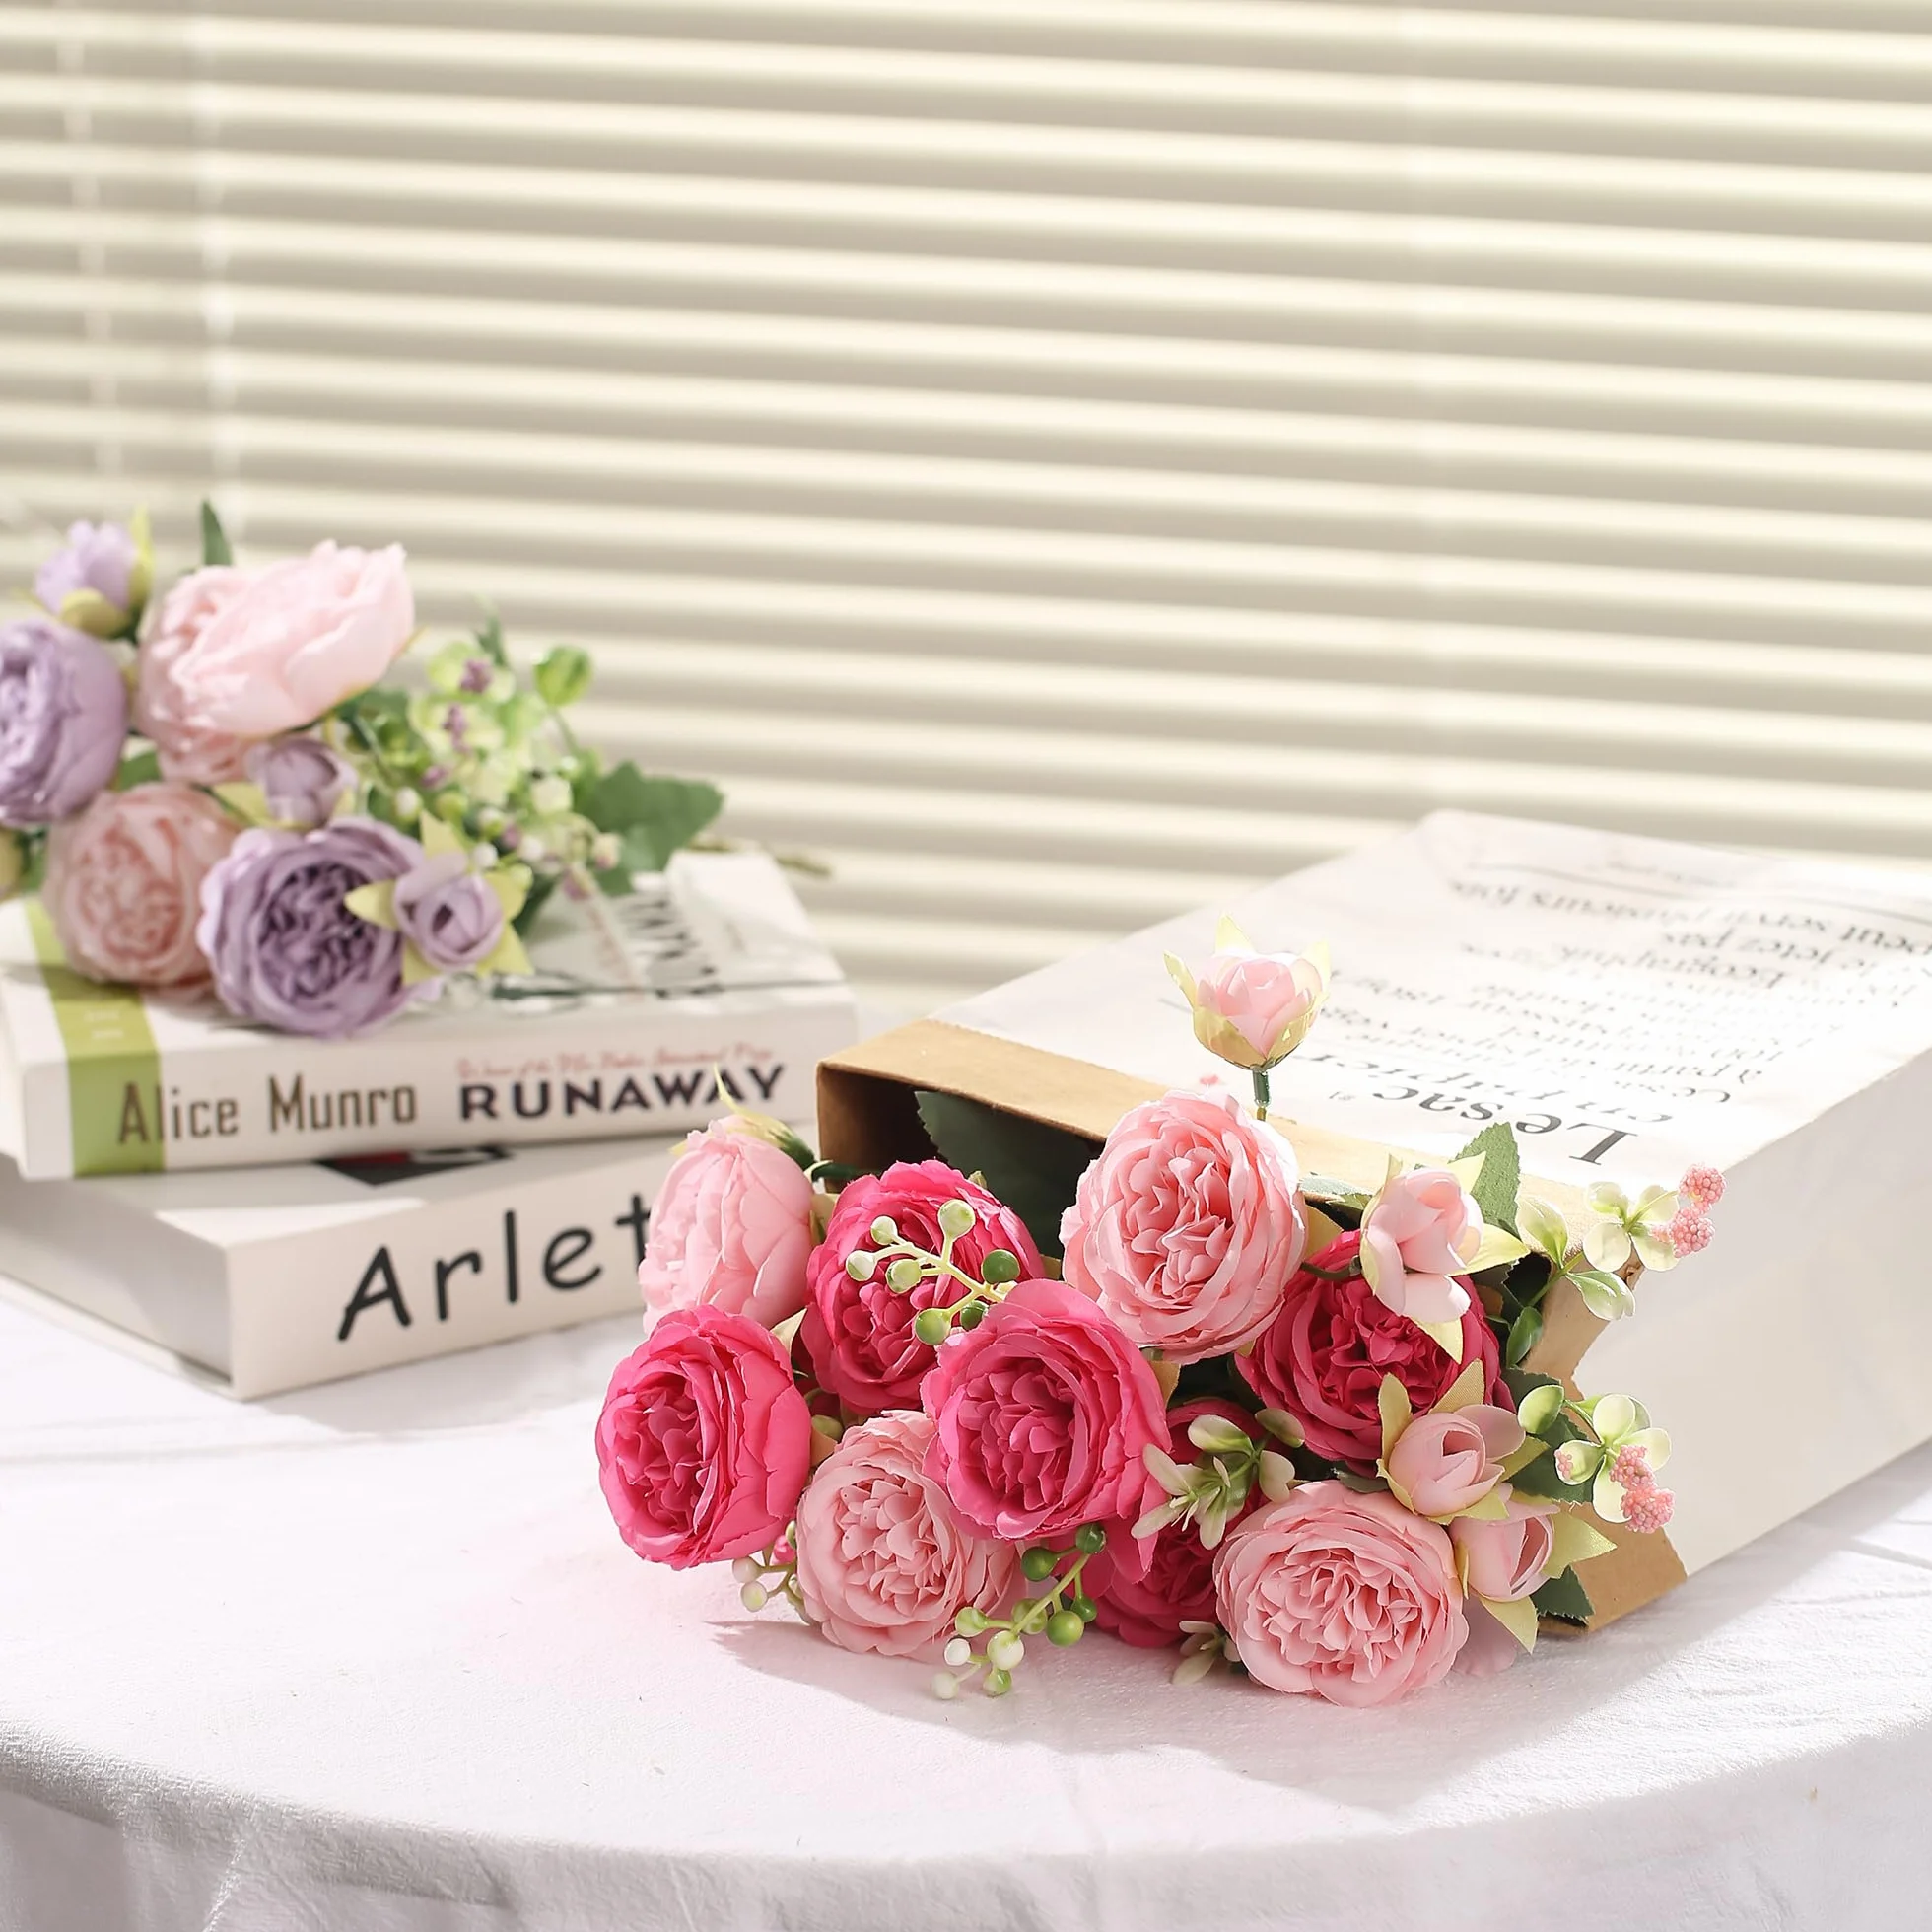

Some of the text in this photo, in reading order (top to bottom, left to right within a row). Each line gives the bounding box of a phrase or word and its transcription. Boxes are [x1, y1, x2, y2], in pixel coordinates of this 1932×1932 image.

[118, 1072, 416, 1144] Alice Munro
[460, 1064, 784, 1120] RUNAWAY
[1290, 1053, 1674, 1124] en papier
[1372, 1086, 1505, 1121] sac
[1516, 1113, 1638, 1167] Le
